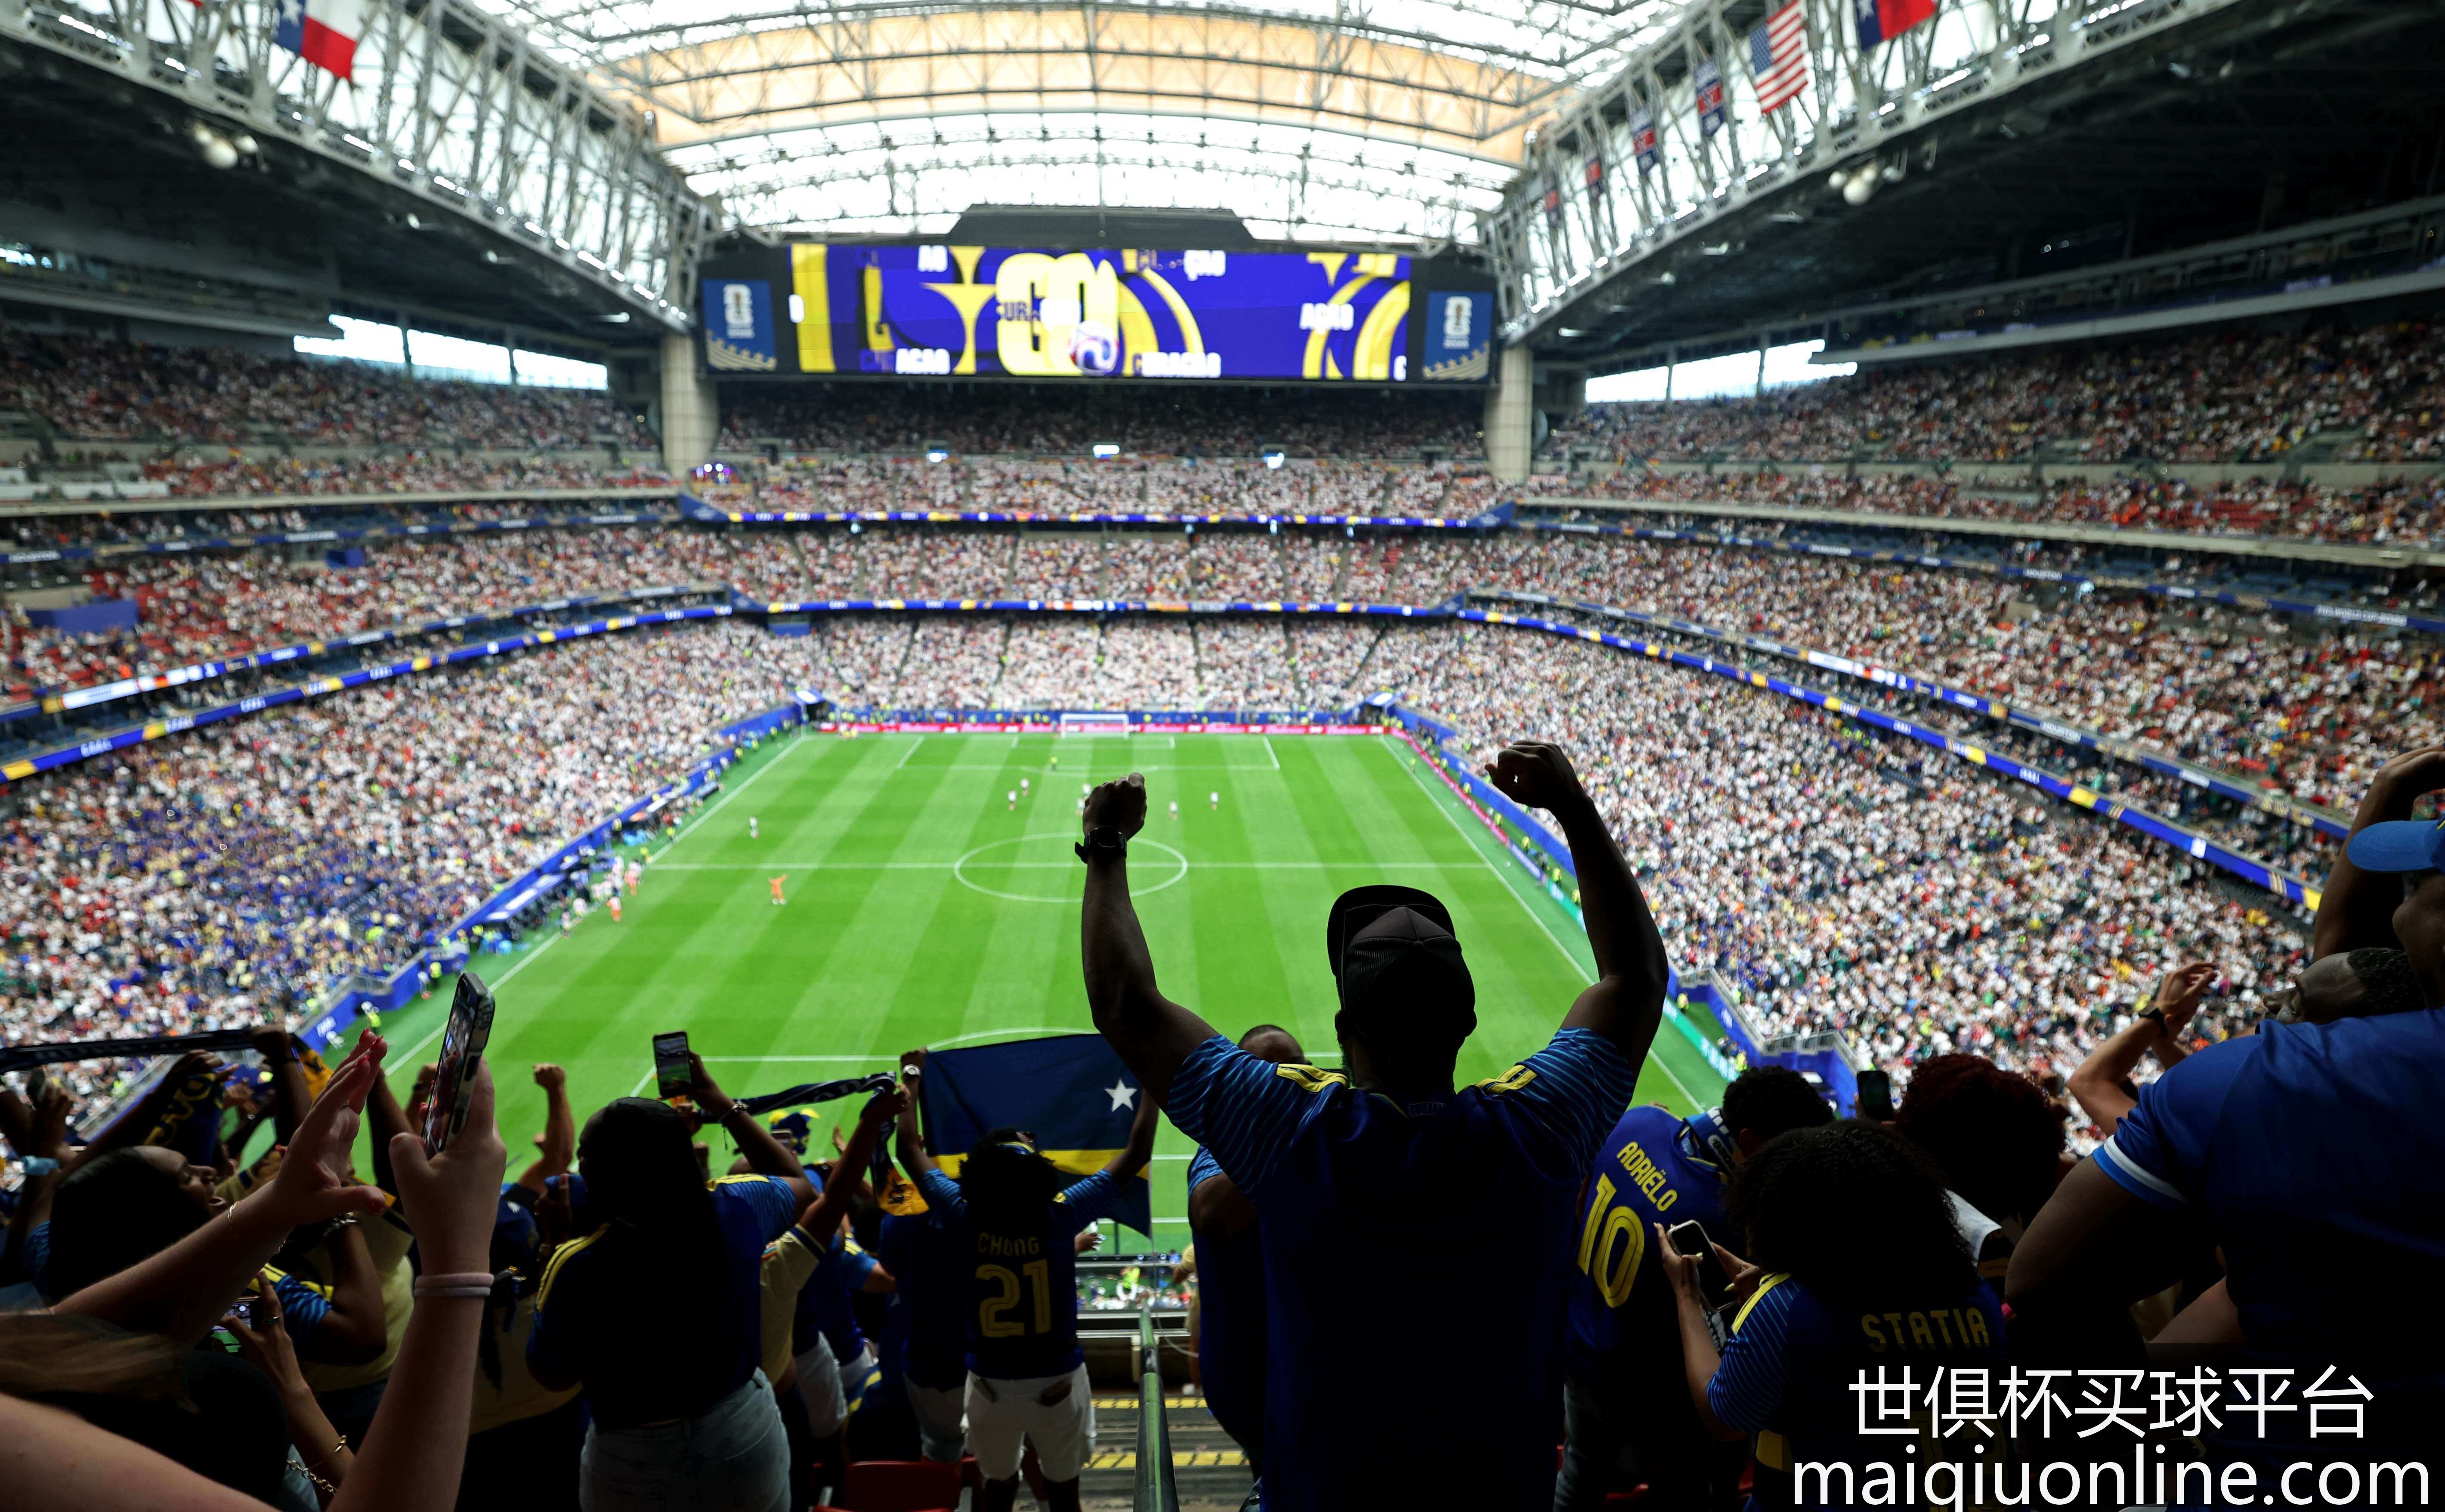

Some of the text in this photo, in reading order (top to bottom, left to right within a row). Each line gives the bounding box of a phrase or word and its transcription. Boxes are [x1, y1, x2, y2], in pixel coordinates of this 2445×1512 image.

[1617, 1141, 1678, 1212] ADRIËLO
[978, 1232, 1039, 1257] CHONG
[1577, 1172, 1645, 1308] 10
[975, 1259, 1051, 1338] 21
[1861, 1307, 1990, 1353] STATIA
